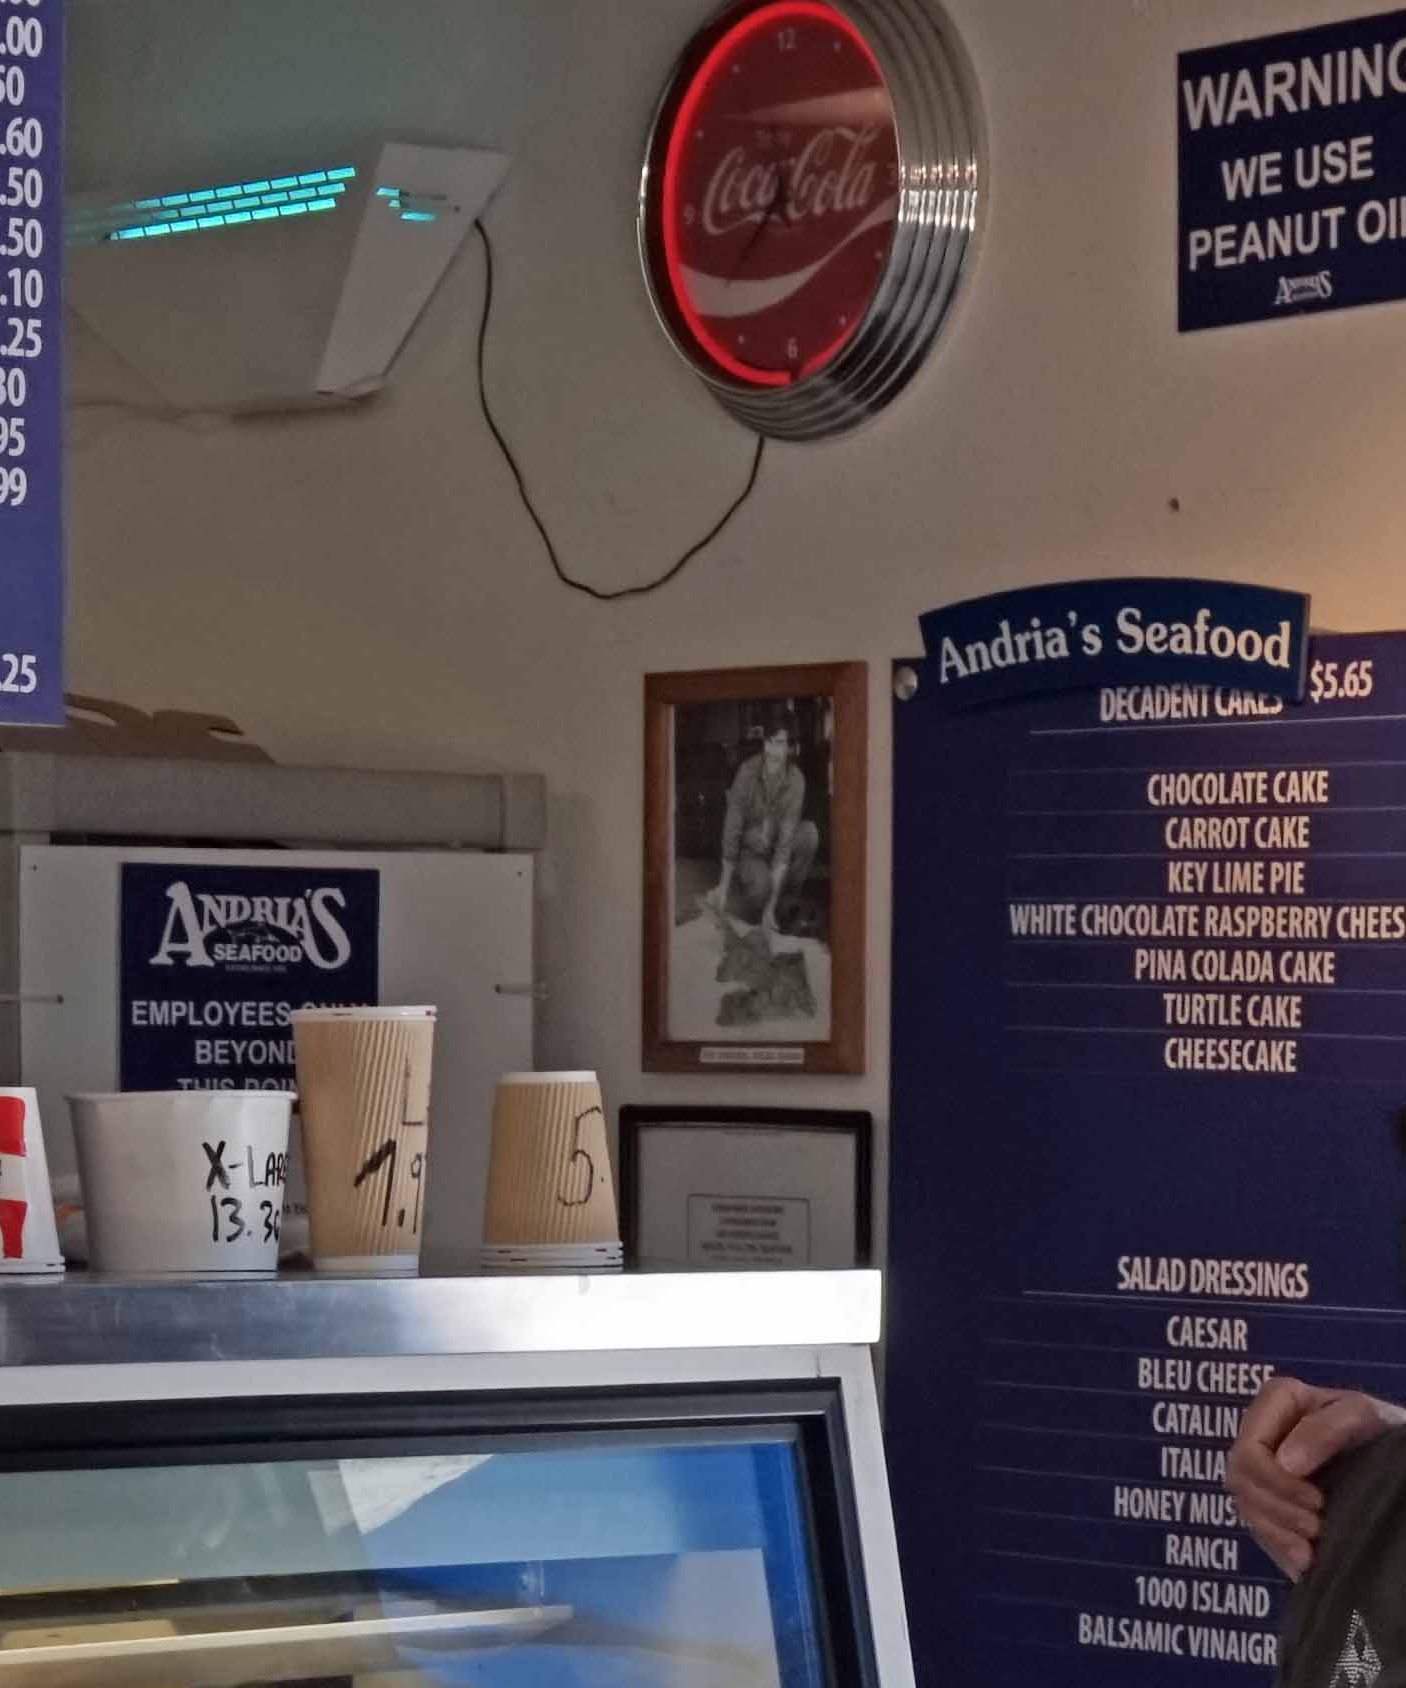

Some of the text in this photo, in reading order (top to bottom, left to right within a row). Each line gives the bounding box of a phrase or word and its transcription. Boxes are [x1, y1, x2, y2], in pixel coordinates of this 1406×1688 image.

[1221, 135, 1375, 201] WE USE
[1189, 206, 1346, 271] PEANUT
[940, 607, 1291, 684] Andria's Seafood
[1310, 659, 1373, 704] $5.65
[1147, 770, 1329, 806] CHOCOLATE CAKE
[1168, 861, 1306, 895] KEY LIME PIE
[149, 881, 351, 969] ANDRIA'S
[1009, 903, 1077, 936] WHITE
[1080, 903, 1200, 937] CHOCOLATE
[1204, 905, 1333, 939] RASPBERRY
[213, 943, 302, 963] SEAFOOD
[1134, 948, 1336, 984] PINA COLADA CAKE
[132, 1000, 291, 1027] EMPLOYEES
[202, 1140, 287, 1192] X-LAR
[1117, 1255, 1309, 1299] SALAD DRESSINGS
[1166, 1315, 1248, 1352] CAESAR
[1138, 1357, 1192, 1391] BLEU
[1165, 1533, 1238, 1571] RANCH
[1135, 1575, 1271, 1618] 1000 ISLAND
[1078, 1612, 1278, 1666] BALSAMIC VINAIGR
